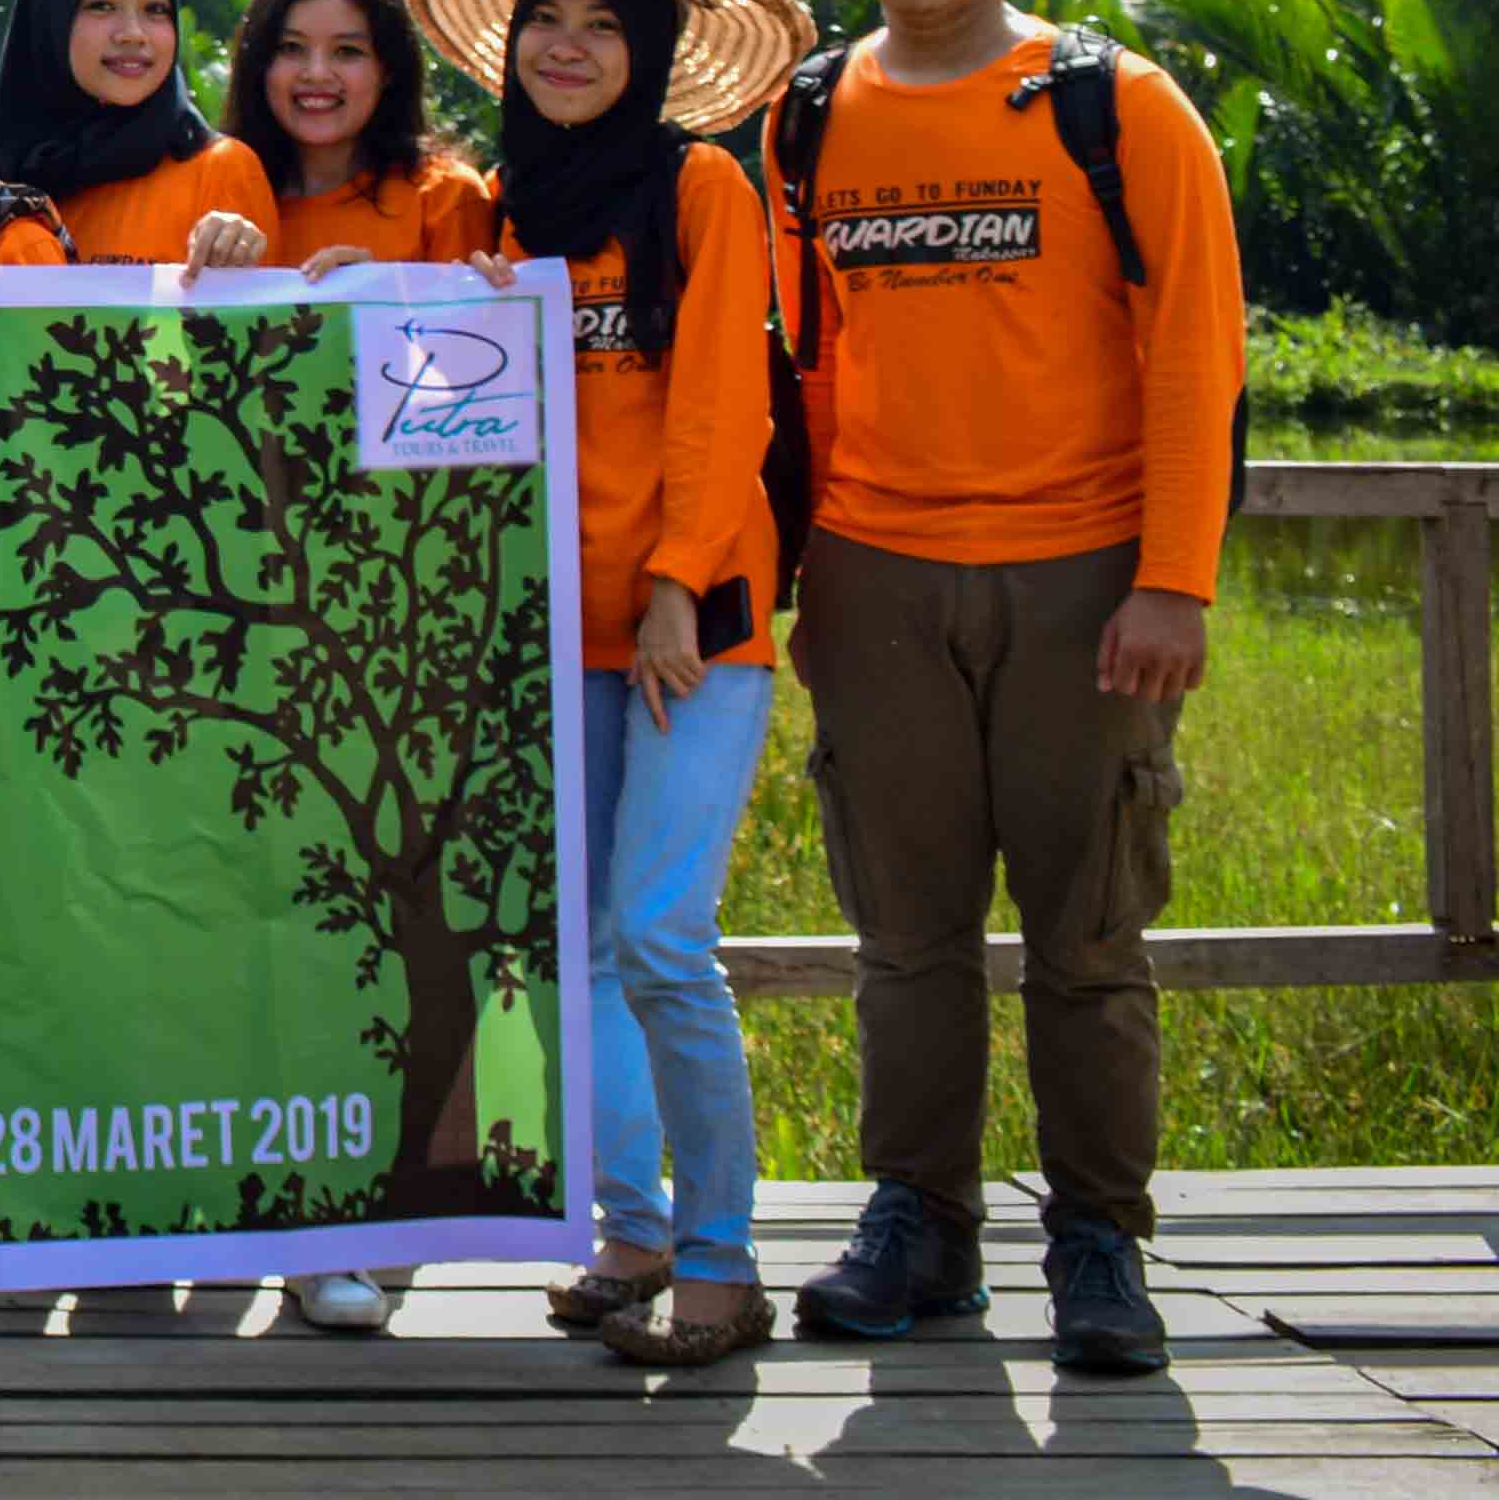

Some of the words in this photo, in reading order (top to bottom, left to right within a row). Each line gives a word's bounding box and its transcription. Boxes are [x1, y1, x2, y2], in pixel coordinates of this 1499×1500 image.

[875, 185, 902, 205] GO
[915, 183, 941, 201] TO
[954, 179, 1041, 198] FUNDAY
[825, 212, 1034, 260] GUARDIAN
[51, 1099, 241, 1174] MARET
[248, 1090, 373, 1165] 2019
